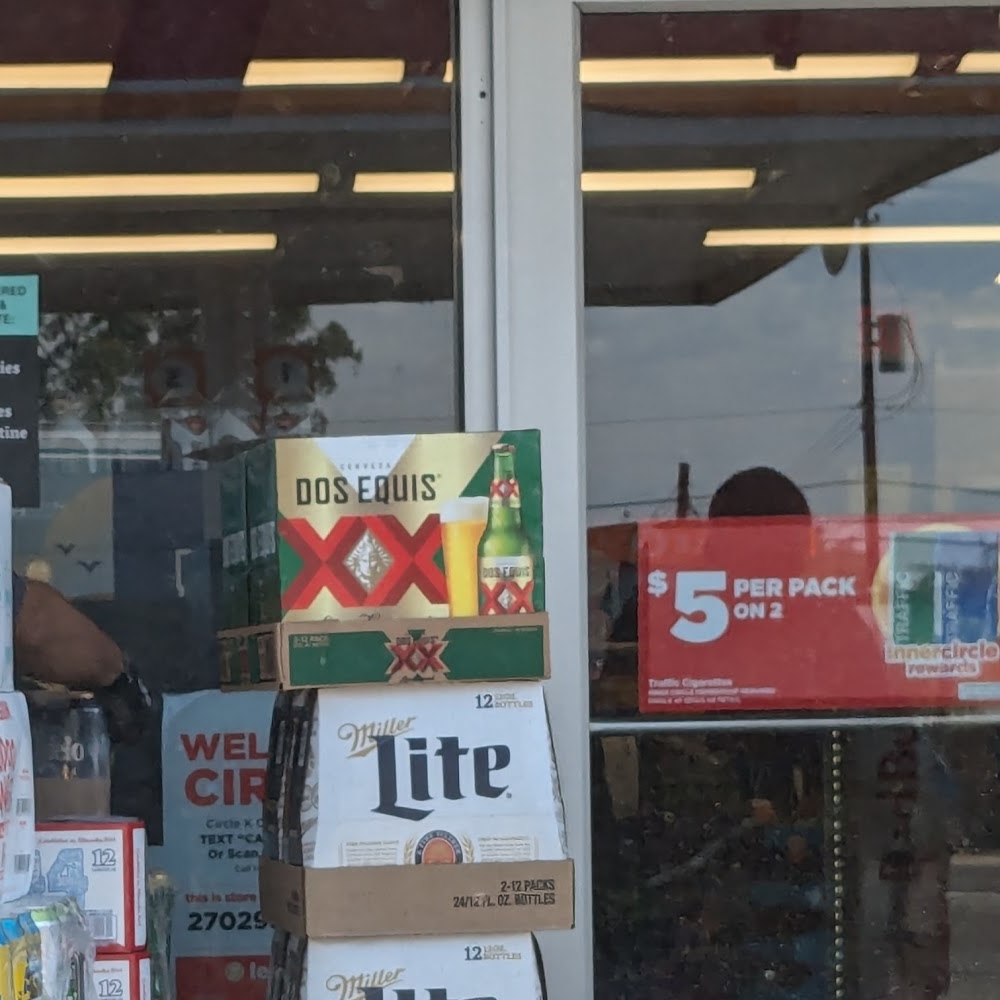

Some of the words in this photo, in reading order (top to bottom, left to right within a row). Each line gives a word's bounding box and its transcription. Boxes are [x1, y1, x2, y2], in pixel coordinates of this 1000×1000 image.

[296, 477, 349, 506] DOS
[358, 474, 437, 506] EQUIS
[733, 577, 783, 598] PER
[788, 575, 856, 597] PACK
[733, 602, 765, 619] ON
[769, 603, 784, 619] 2
[475, 693, 494, 709] 12
[337, 716, 417, 758] Miller
[184, 767, 267, 807] CIR
[368, 735, 512, 822] Lite
[200, 834, 233, 845] TEXT
[92, 848, 117, 867] 12
[501, 881, 523, 892] 2-12
[524, 879, 556, 892] PACKS
[514, 893, 556, 906] BOTTLES
[464, 946, 483, 961] 12
[98, 978, 124, 997] 12
